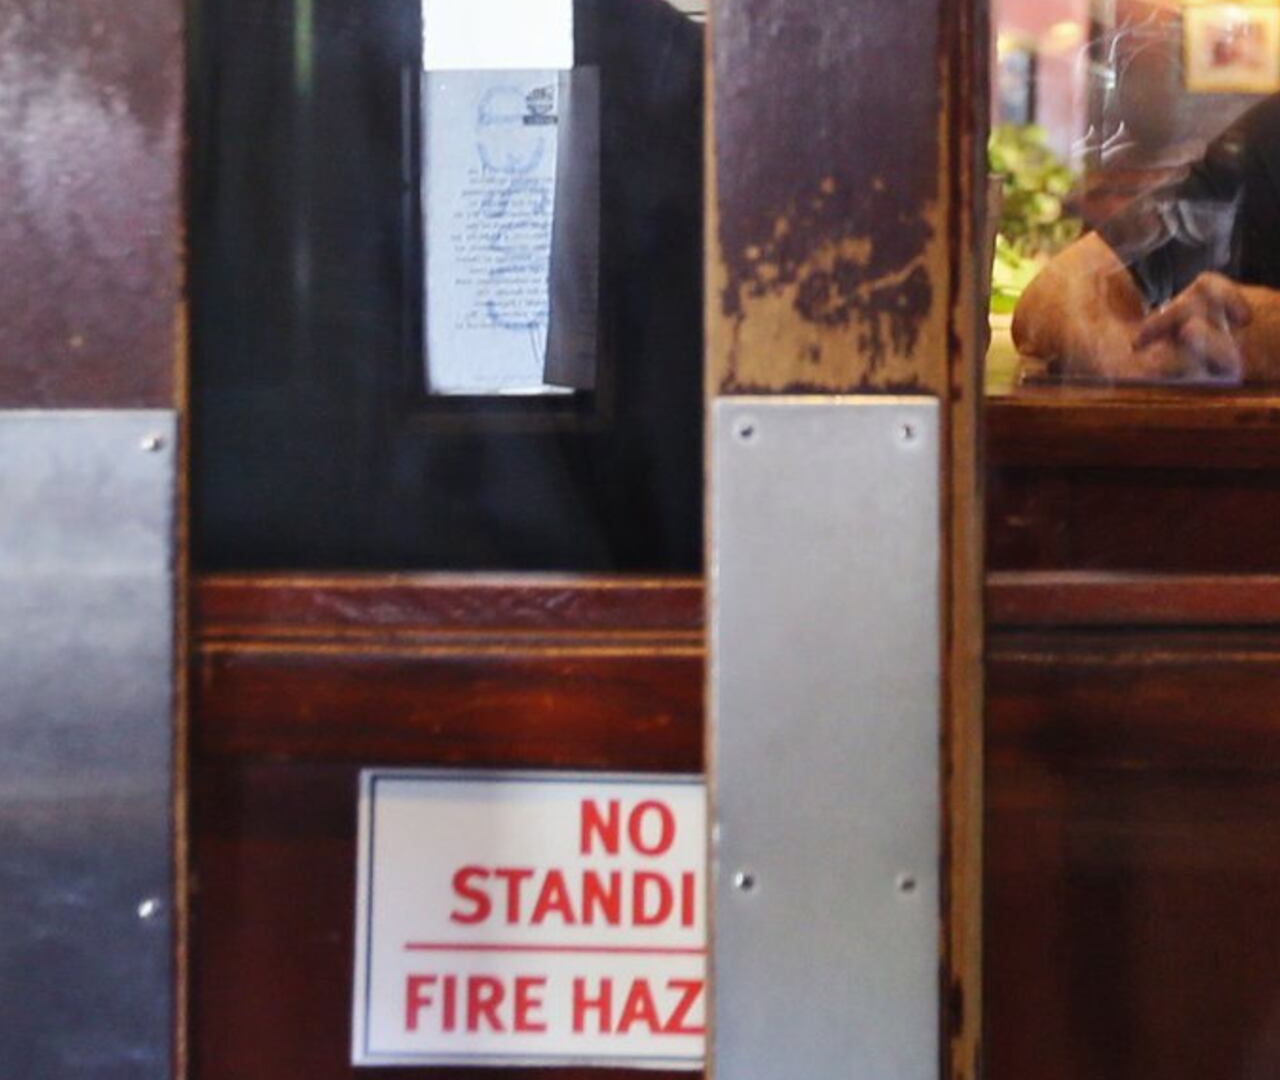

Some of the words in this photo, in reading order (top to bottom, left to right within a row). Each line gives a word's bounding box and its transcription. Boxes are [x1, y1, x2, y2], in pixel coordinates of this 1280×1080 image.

[579, 798, 676, 857] NO
[450, 865, 696, 928] STANDI
[405, 974, 548, 1035] FIRE
[572, 977, 707, 1036] HAZ
